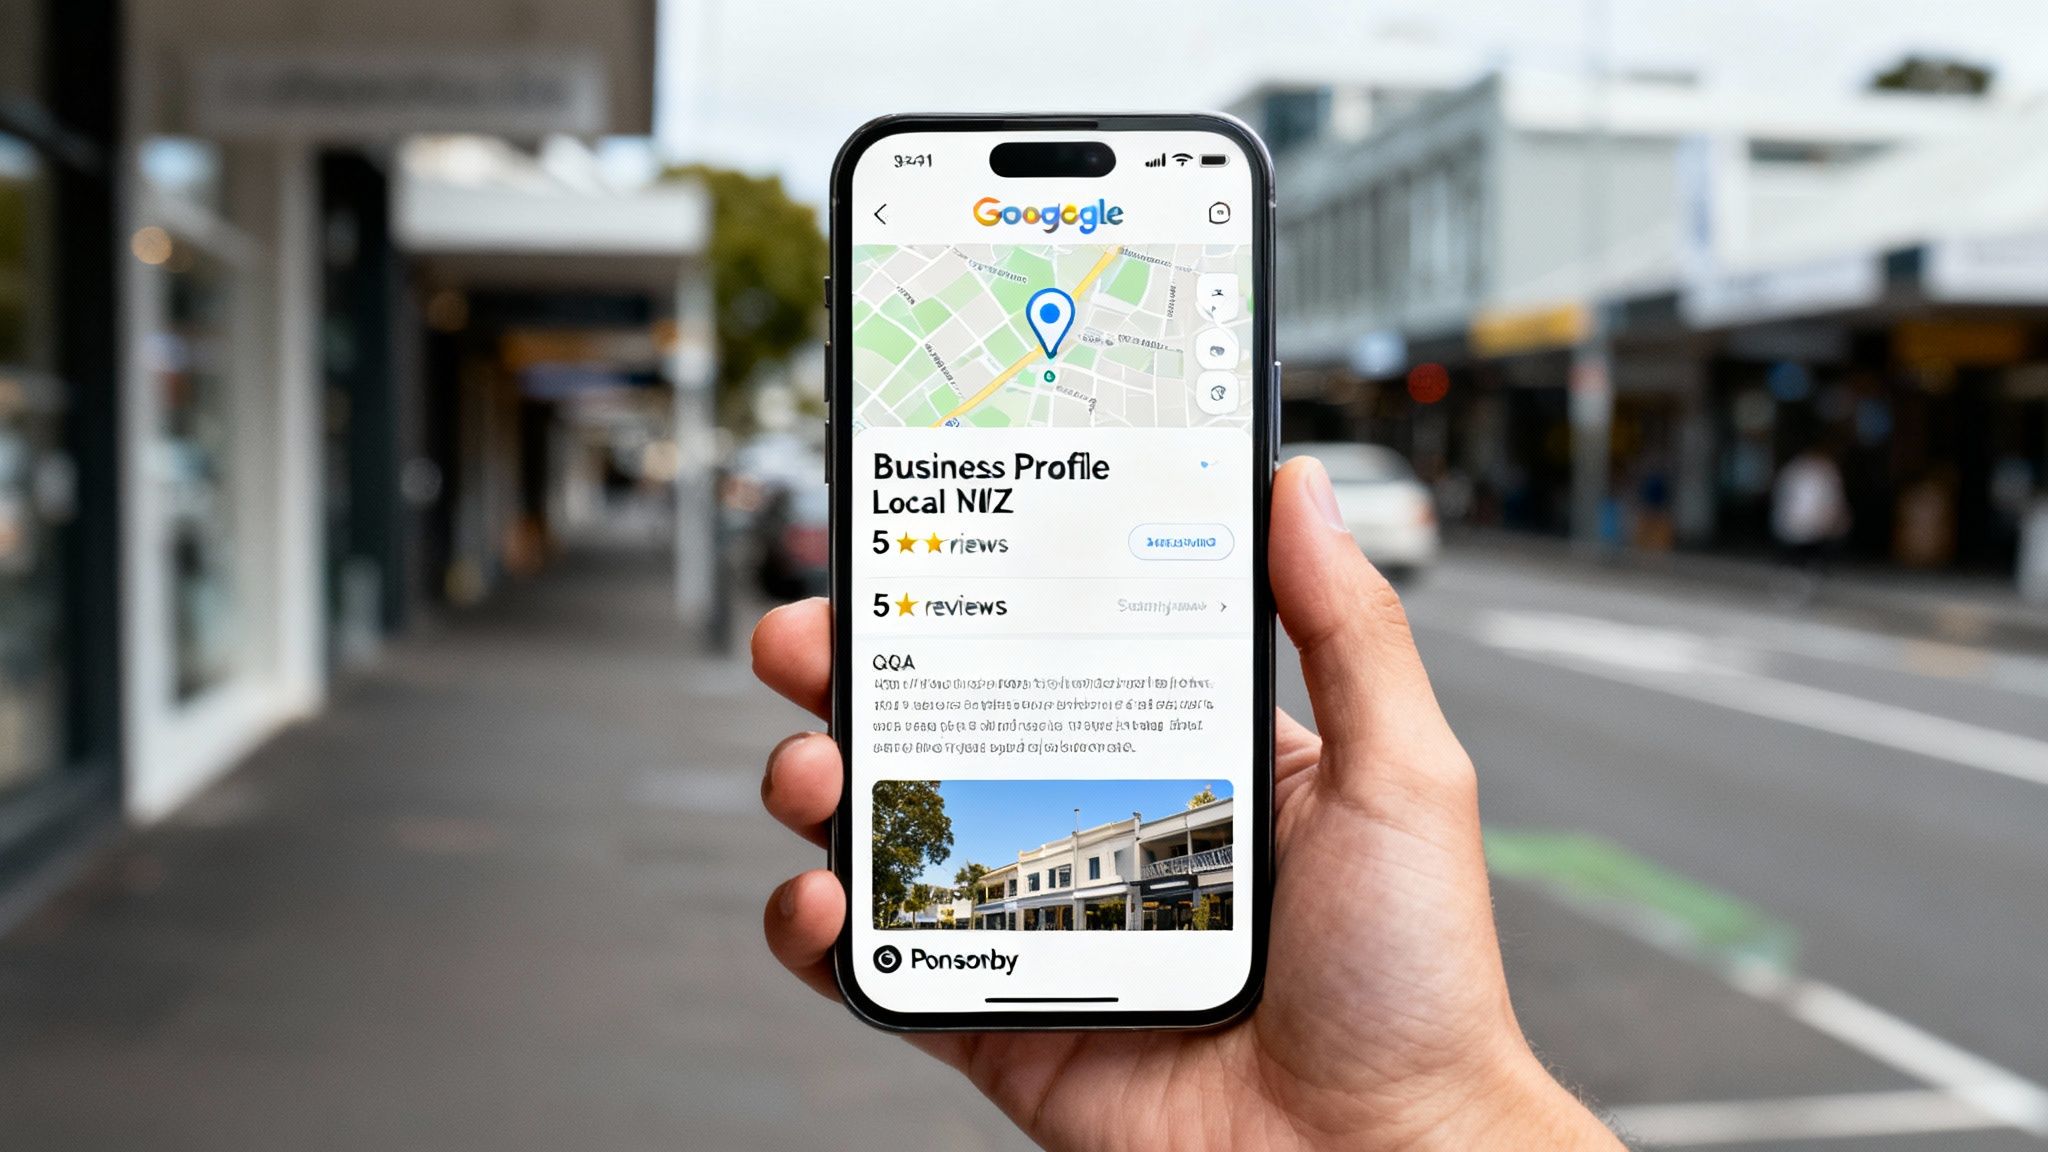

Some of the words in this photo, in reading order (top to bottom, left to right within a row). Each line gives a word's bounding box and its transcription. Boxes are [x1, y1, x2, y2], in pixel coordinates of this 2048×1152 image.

[874, 452, 1006, 480] Business
[1014, 451, 1110, 480] Profile
[873, 489, 946, 514] Local
[872, 529, 890, 555] 5
[872, 592, 890, 618] 5
[925, 594, 1008, 617] reviews
